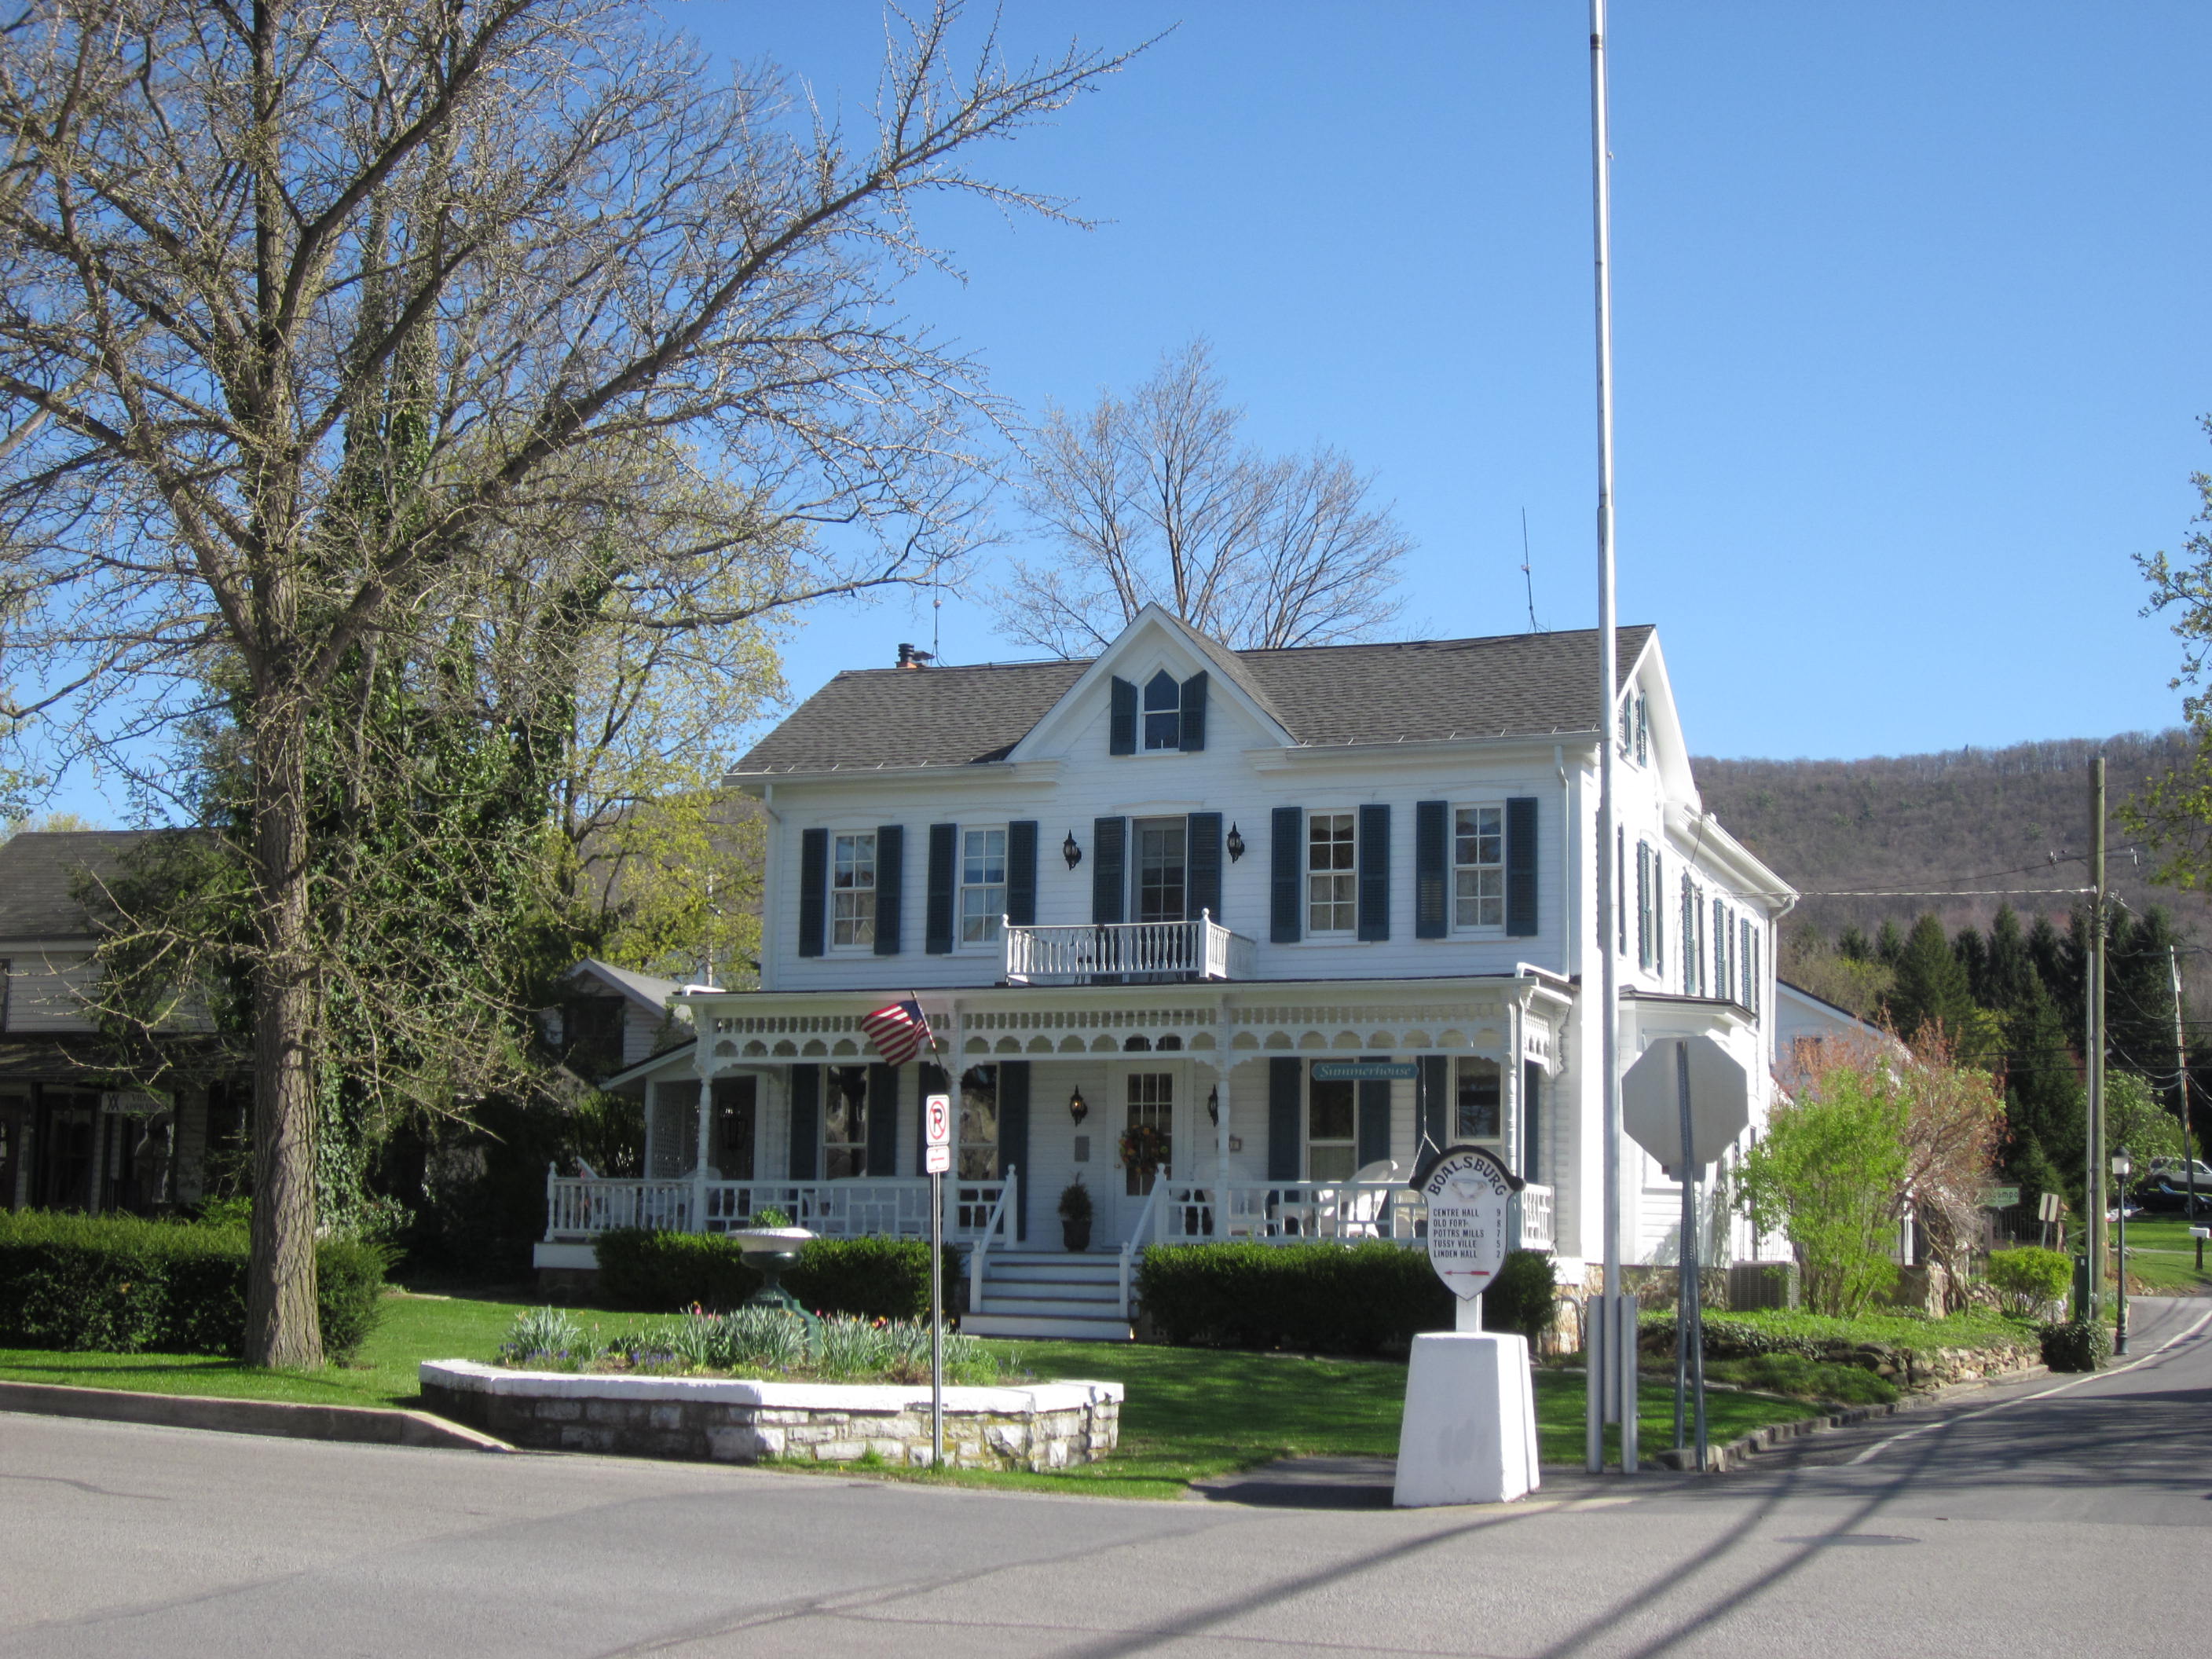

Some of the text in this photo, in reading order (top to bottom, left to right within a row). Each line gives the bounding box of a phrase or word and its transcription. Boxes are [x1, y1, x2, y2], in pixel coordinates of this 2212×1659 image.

[1320, 1064, 1411, 1078] Summerhouse
[1428, 1156, 1507, 1196] BOALSBURG
[1433, 1208, 1501, 1217] CENTRE HALL 9
[1433, 1229, 1459, 1238] POTTRS
[1463, 1229, 1484, 1238] MILLS
[1496, 1250, 1501, 1258] 2
